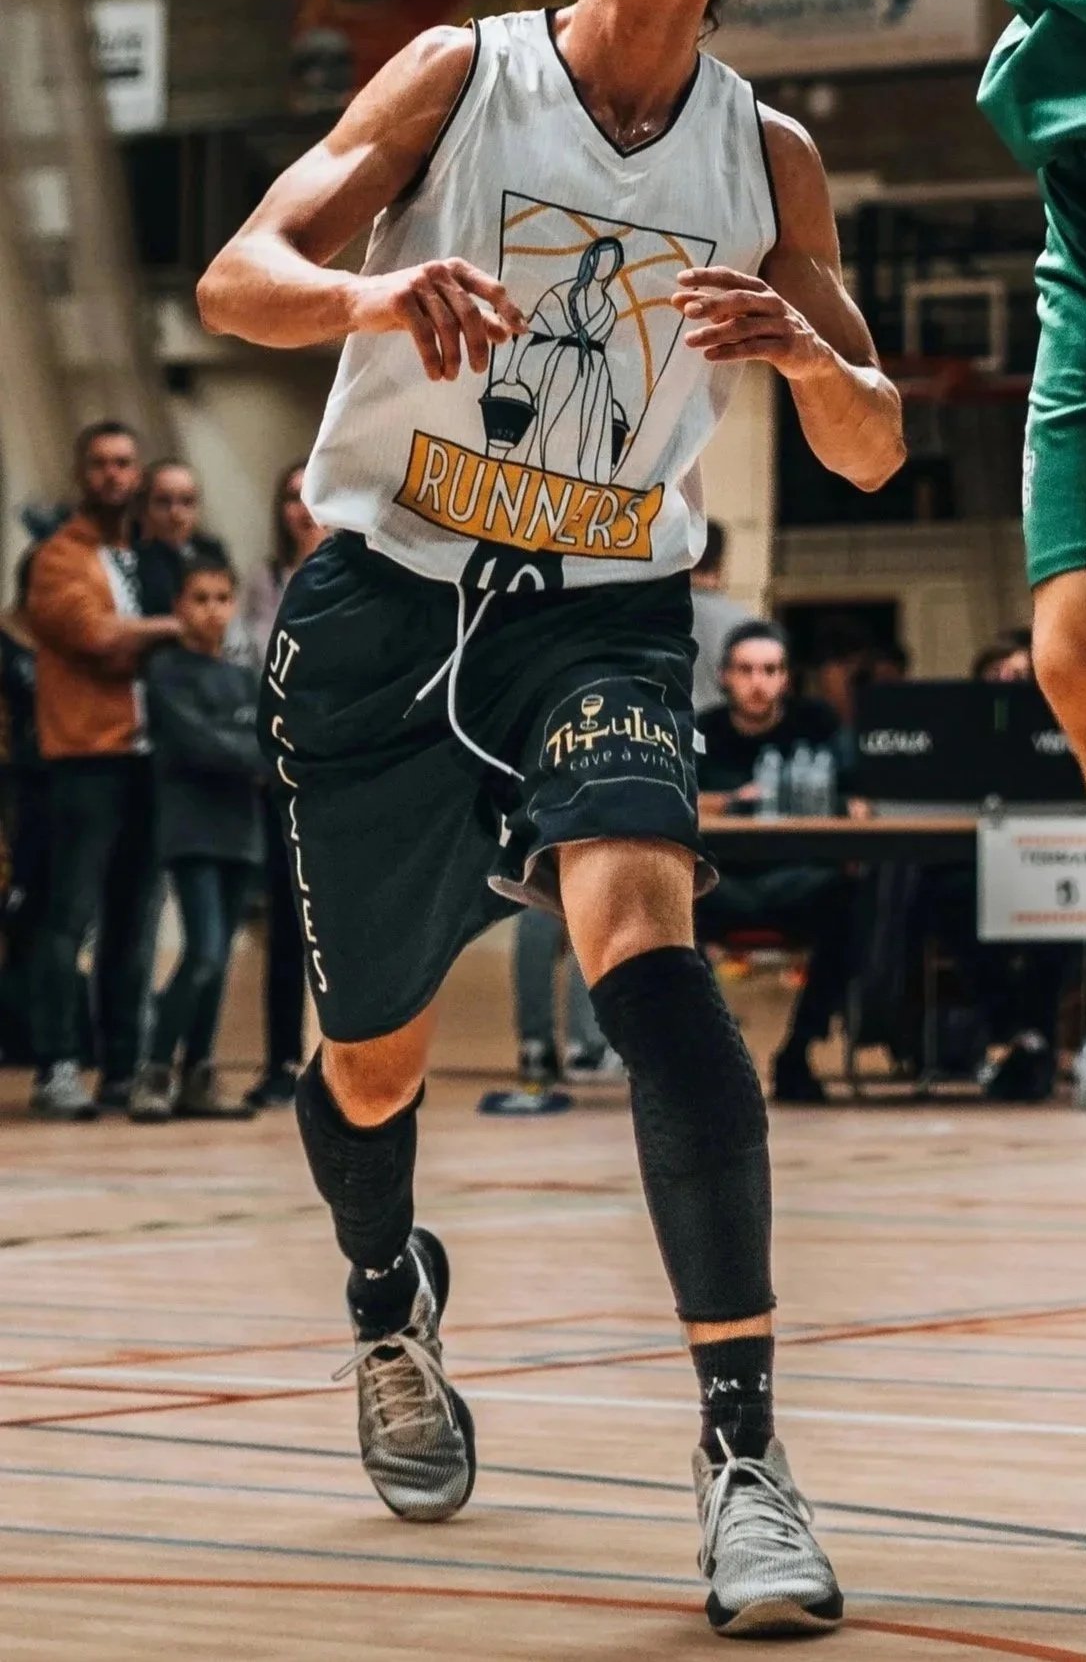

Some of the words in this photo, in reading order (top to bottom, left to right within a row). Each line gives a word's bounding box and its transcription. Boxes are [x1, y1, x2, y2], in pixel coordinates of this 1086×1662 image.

[415, 440, 645, 550] RUNNERS
[569, 750, 613, 772] cave
[621, 746, 633, 763] à
